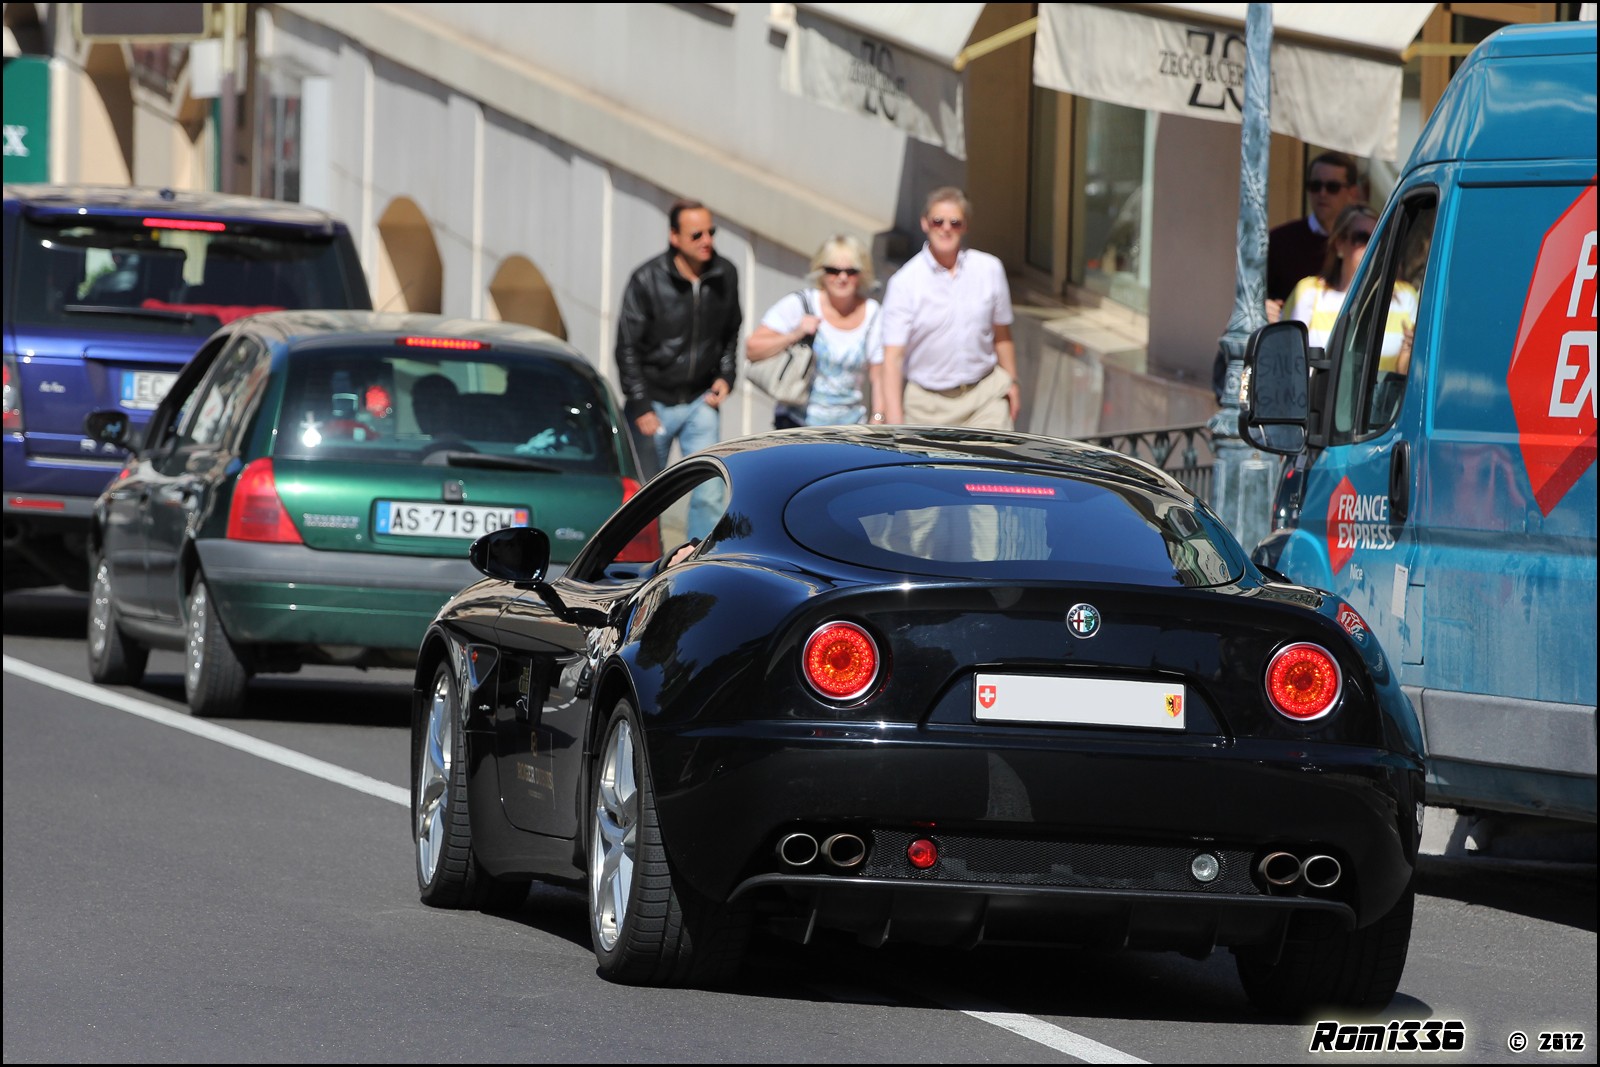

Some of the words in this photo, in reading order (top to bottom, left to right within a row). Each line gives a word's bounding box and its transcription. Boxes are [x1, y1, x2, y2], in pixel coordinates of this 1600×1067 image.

[1159, 50, 1202, 79] ZEGG
[1566, 230, 1598, 318] F
[1338, 494, 1388, 521] FRANCE
[1337, 522, 1397, 550] EXPRESS
[1349, 563, 1364, 581] Nice
